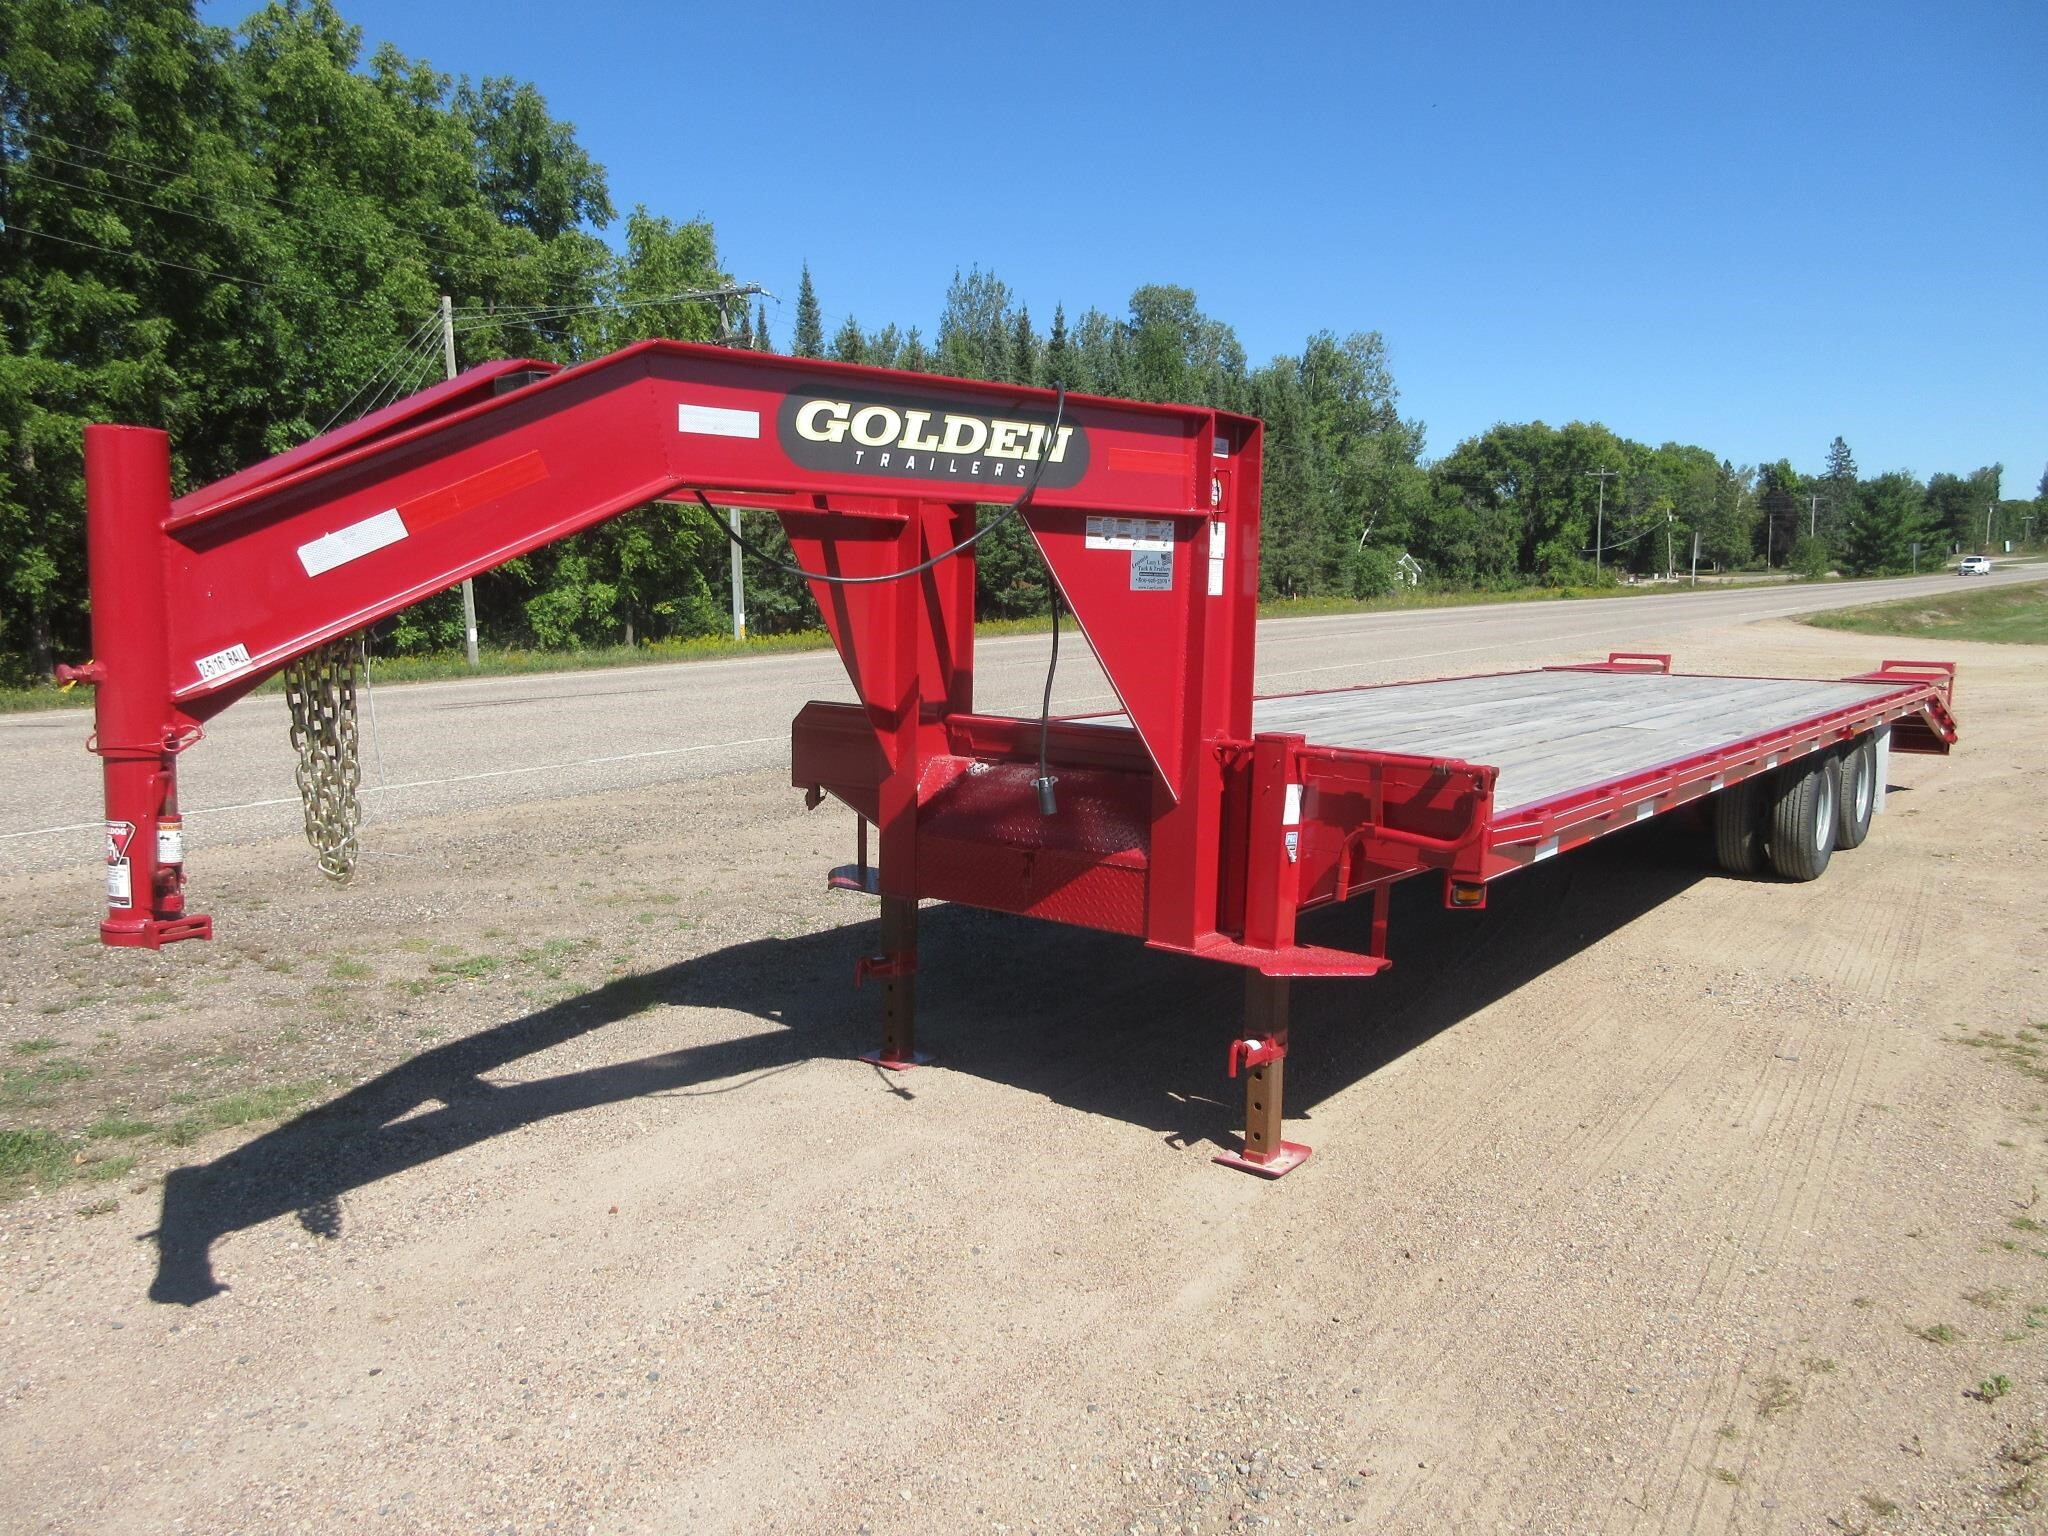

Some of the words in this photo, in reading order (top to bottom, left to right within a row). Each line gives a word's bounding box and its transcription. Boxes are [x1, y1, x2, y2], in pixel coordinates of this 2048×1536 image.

[795, 400, 1073, 463] GOLDEN
[854, 450, 1026, 478] TRAILERS
[226, 647, 249, 665] BALL
